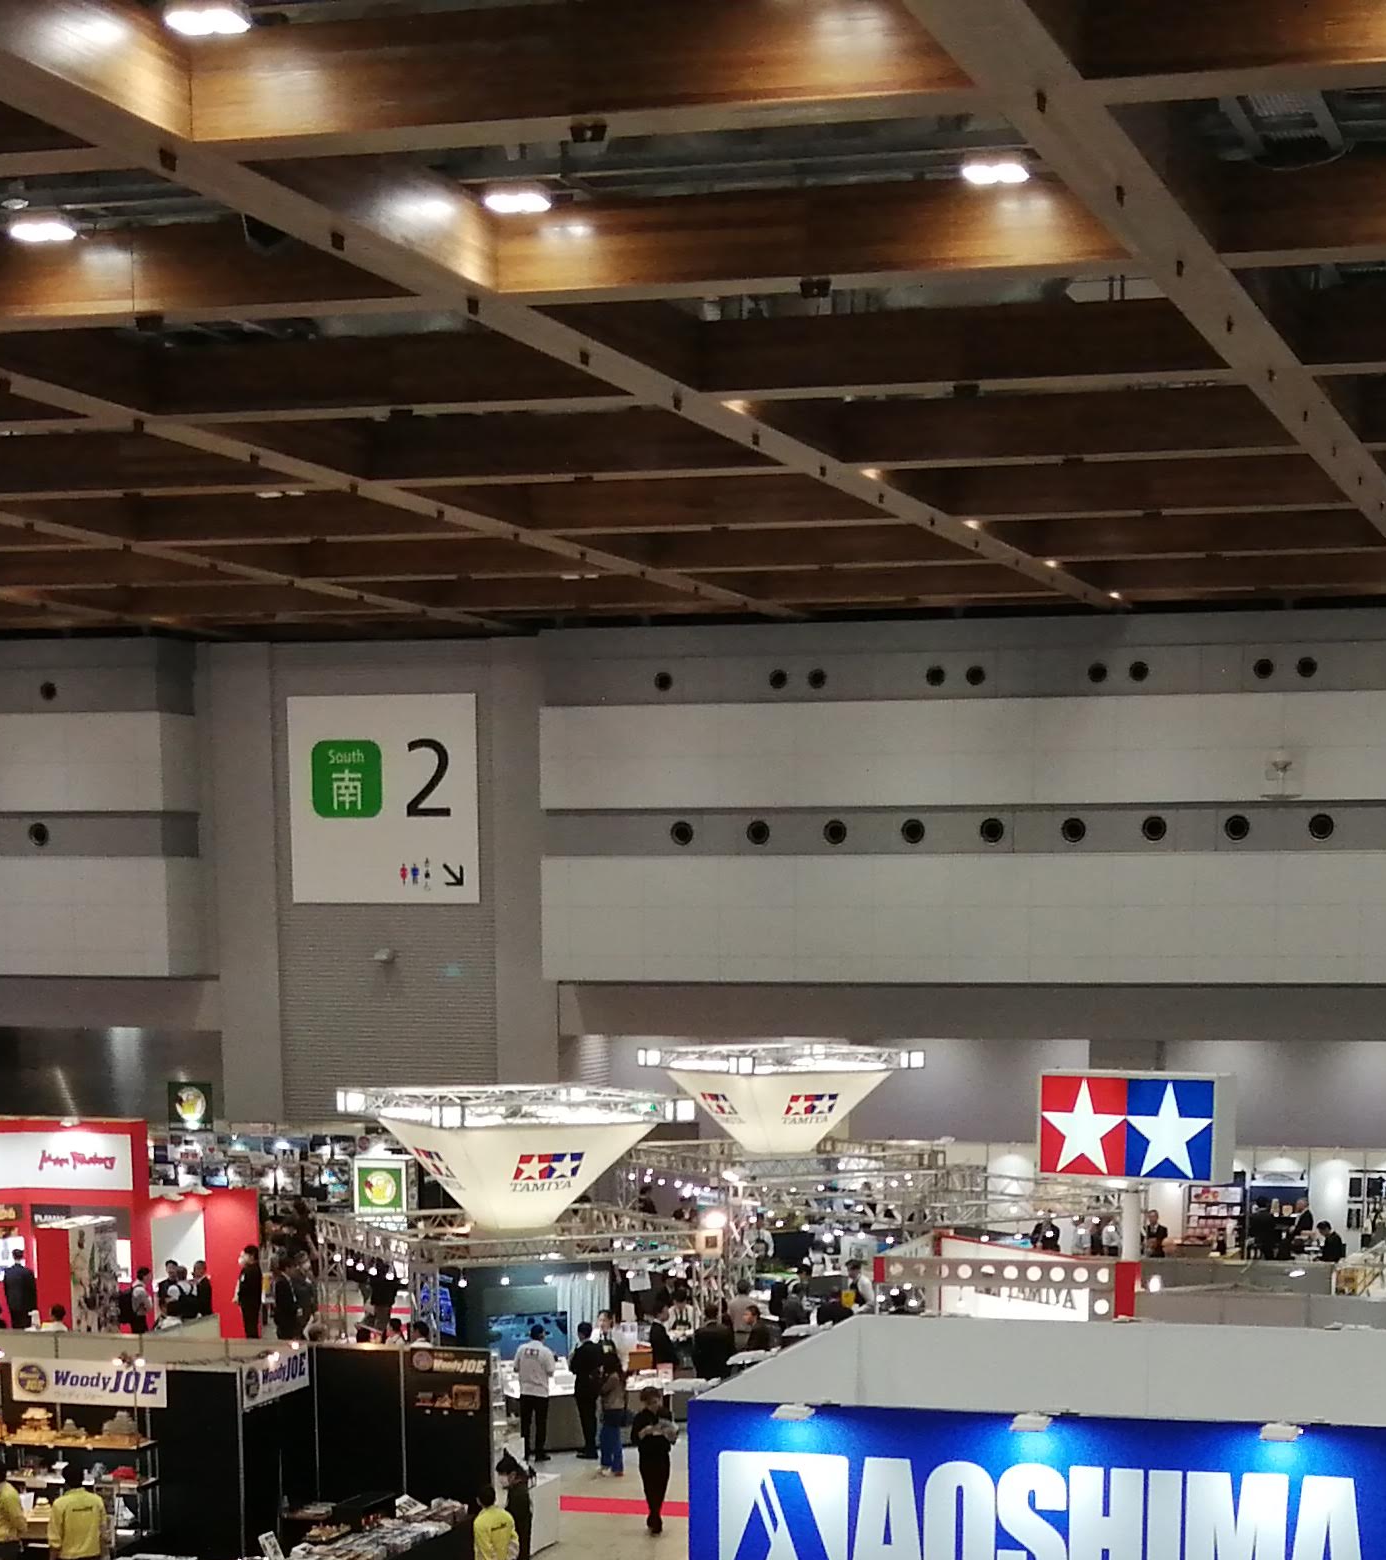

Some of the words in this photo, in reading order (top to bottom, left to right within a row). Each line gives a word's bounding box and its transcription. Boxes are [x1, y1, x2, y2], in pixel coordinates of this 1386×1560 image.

[328, 749, 365, 764] South
[332, 769, 361, 810] 南
[406, 738, 451, 817] 2
[510, 1180, 573, 1193] TAMIYA
